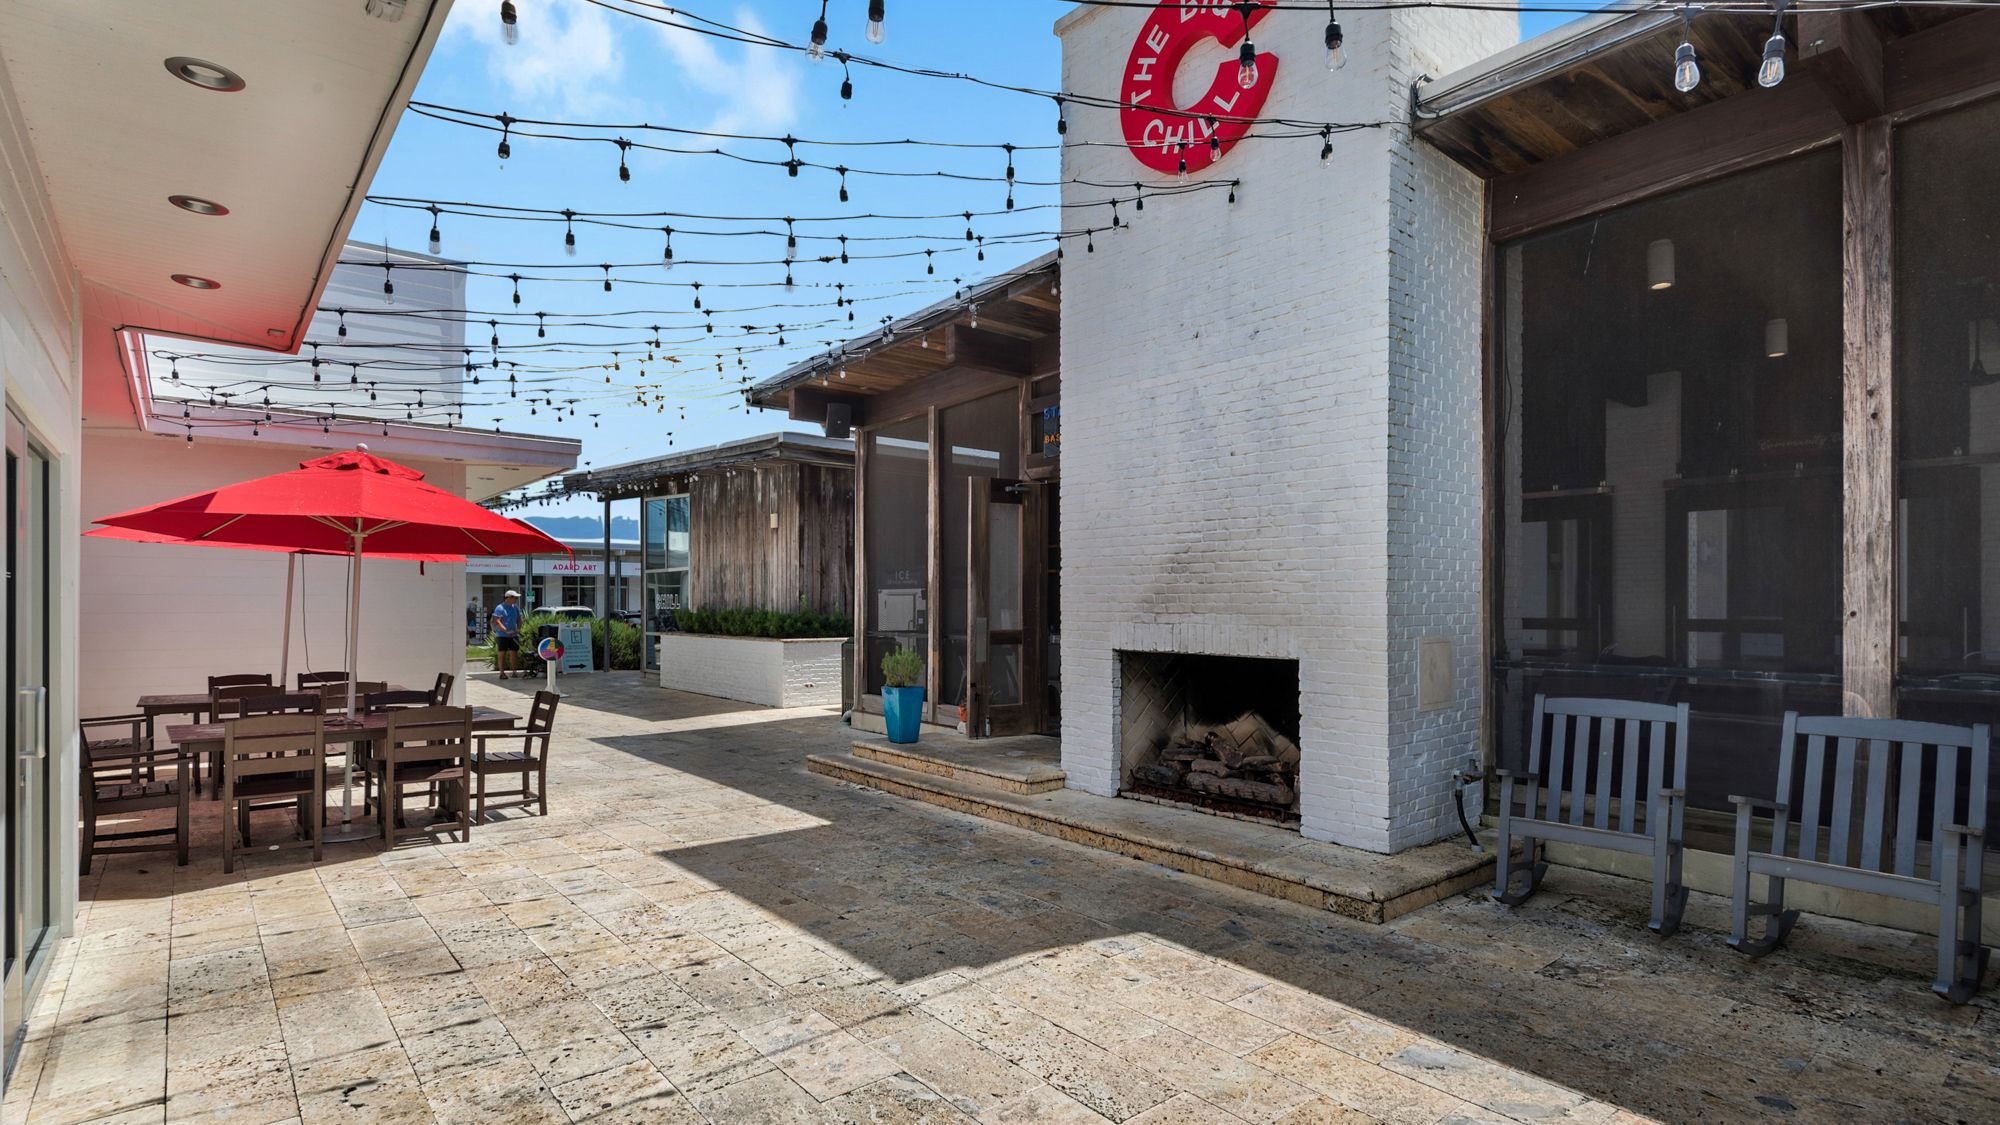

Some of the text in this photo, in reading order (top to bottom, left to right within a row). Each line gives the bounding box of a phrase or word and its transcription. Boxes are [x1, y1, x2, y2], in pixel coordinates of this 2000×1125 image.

[1131, 24, 1170, 112] THE
[1143, 91, 1240, 155] CHILL
[583, 564, 597, 572] ART
[895, 570, 910, 580] ICE
